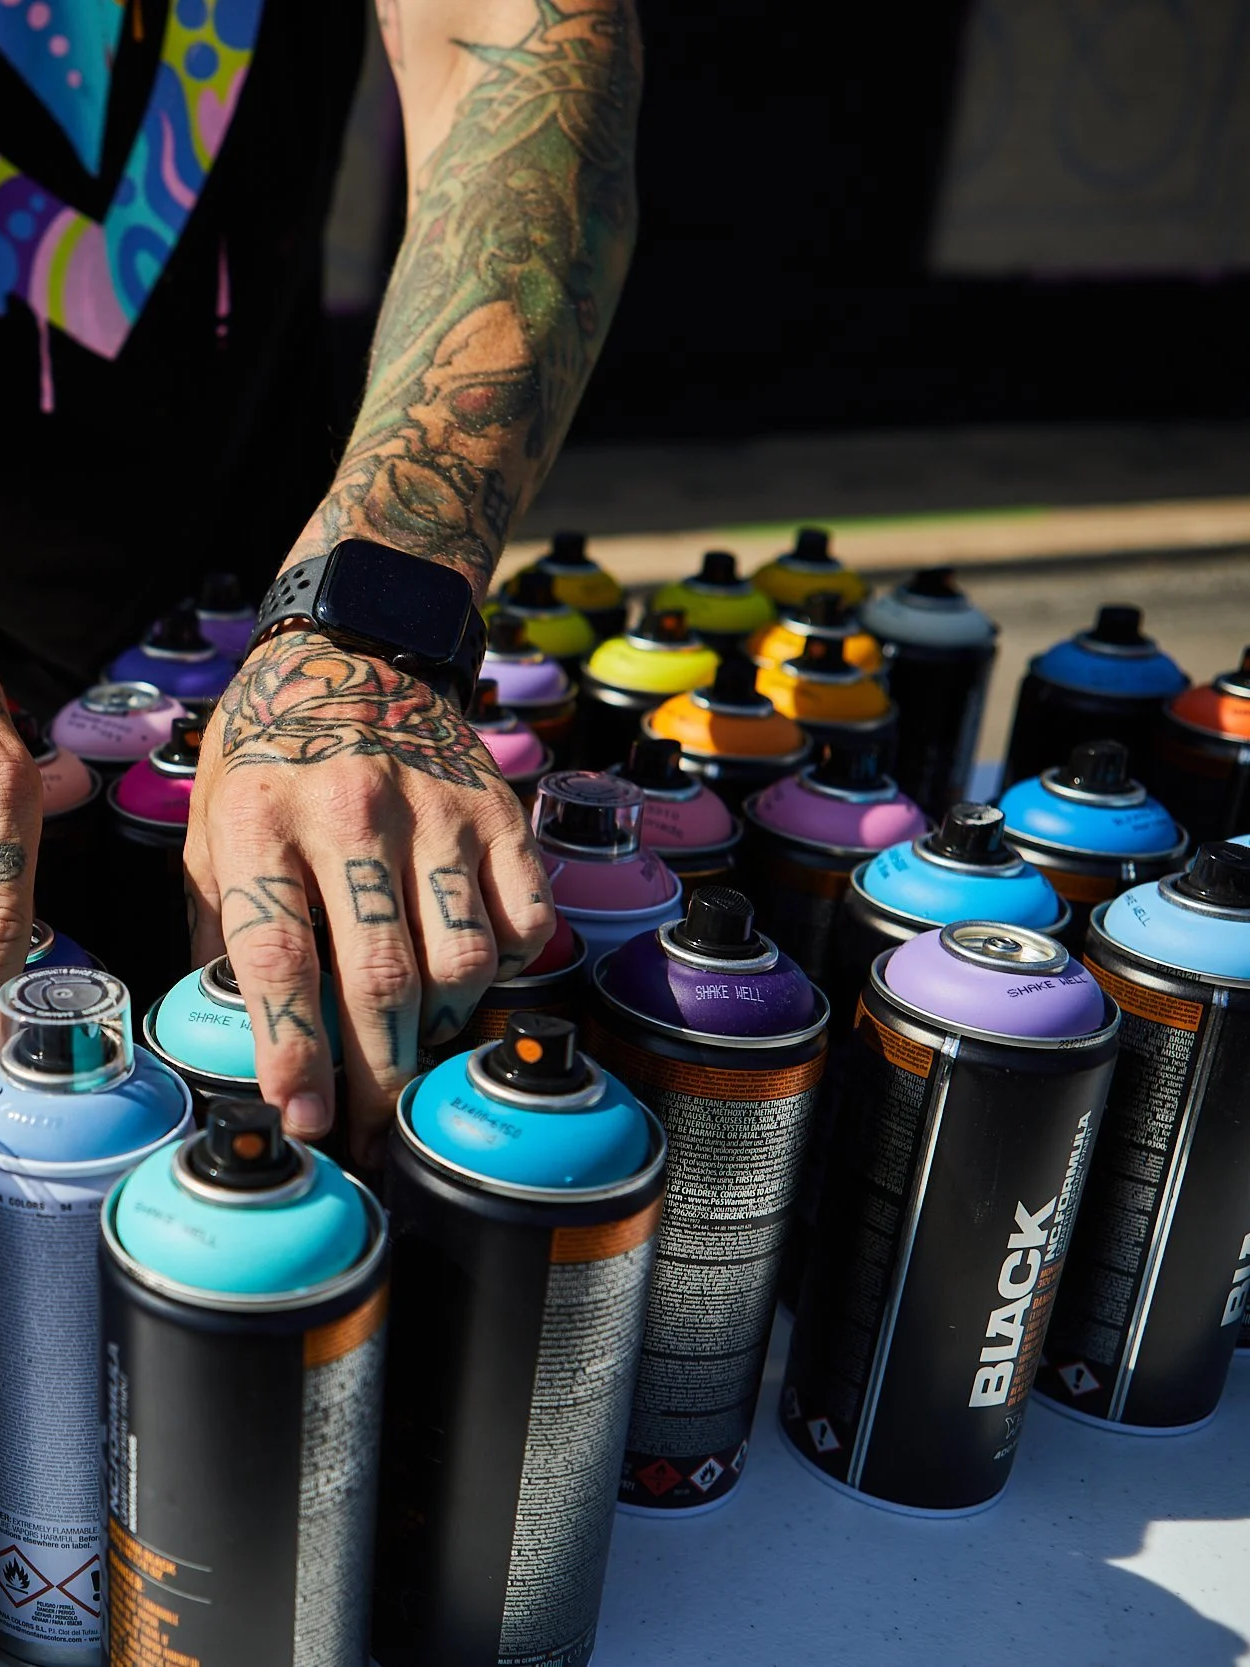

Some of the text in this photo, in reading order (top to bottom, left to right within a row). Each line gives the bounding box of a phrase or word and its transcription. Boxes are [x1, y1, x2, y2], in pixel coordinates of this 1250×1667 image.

[1007, 975, 1088, 998] SHAKE WELL
[695, 985, 764, 1002] SHAKE WELL
[188, 1011, 233, 1026] SHAKE
[1160, 1024, 1195, 1039] NAPHTHA
[1169, 1035, 1193, 1047] BRAIN
[1161, 1048, 1190, 1061] MISUSE
[1148, 1118, 1173, 1130] Cancer
[1156, 1113, 1175, 1122] KEEP
[685, 1118, 750, 1132] NERVOUS SYSTEM
[690, 1127, 726, 1139] HARMFUL
[968, 1196, 1057, 1408] BLACK
[12, 1519, 51, 1532] EXTREMELY
[13, 1526, 39, 1539] VAPORS
[23, 1537, 59, 1549] elsewhere
[11, 1616, 34, 1630] COLORS
